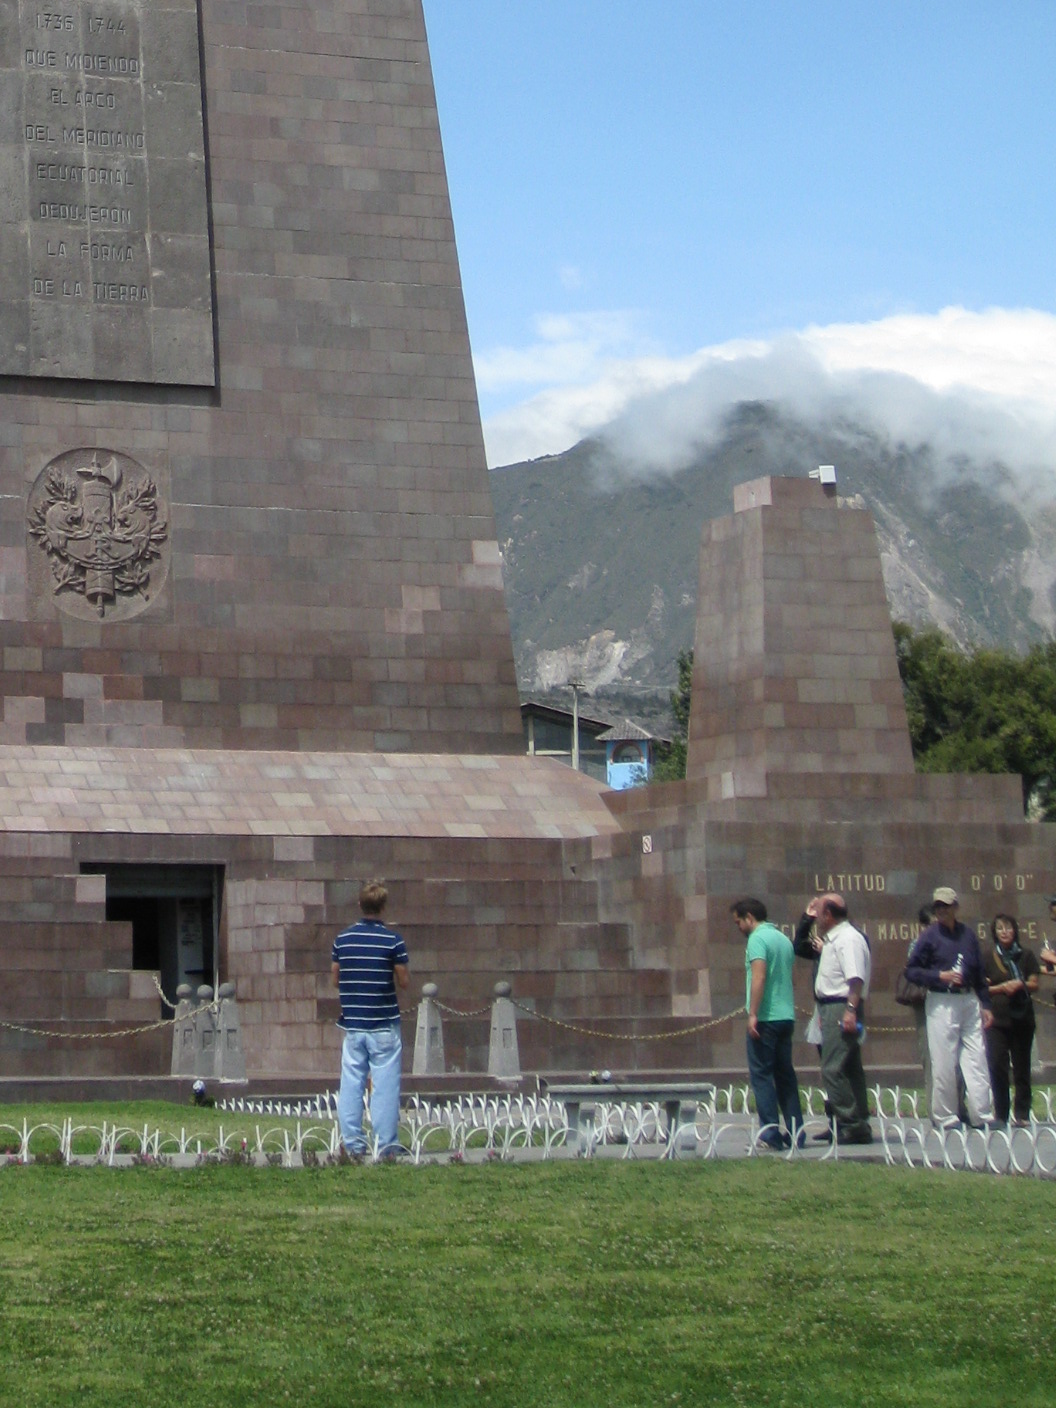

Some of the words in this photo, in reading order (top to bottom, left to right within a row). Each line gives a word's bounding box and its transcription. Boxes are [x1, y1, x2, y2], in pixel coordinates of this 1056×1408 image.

[25, 49, 56, 66] QUE
[64, 52, 139, 73] MIDIENDO
[50, 89, 68, 105] EL
[75, 92, 115, 110] ARCO
[26, 124, 55, 143] DEL
[63, 128, 145, 149] MERIDIANO
[37, 163, 134, 186] ECUATORIAL
[39, 202, 131, 224] DEDUJERON
[46, 242, 67, 259] LA
[80, 244, 133, 262] FORMA
[34, 278, 53, 295] DE
[63, 280, 82, 297] LA
[93, 282, 149, 302] TIERRA
[814, 873, 885, 892] LATITUD
